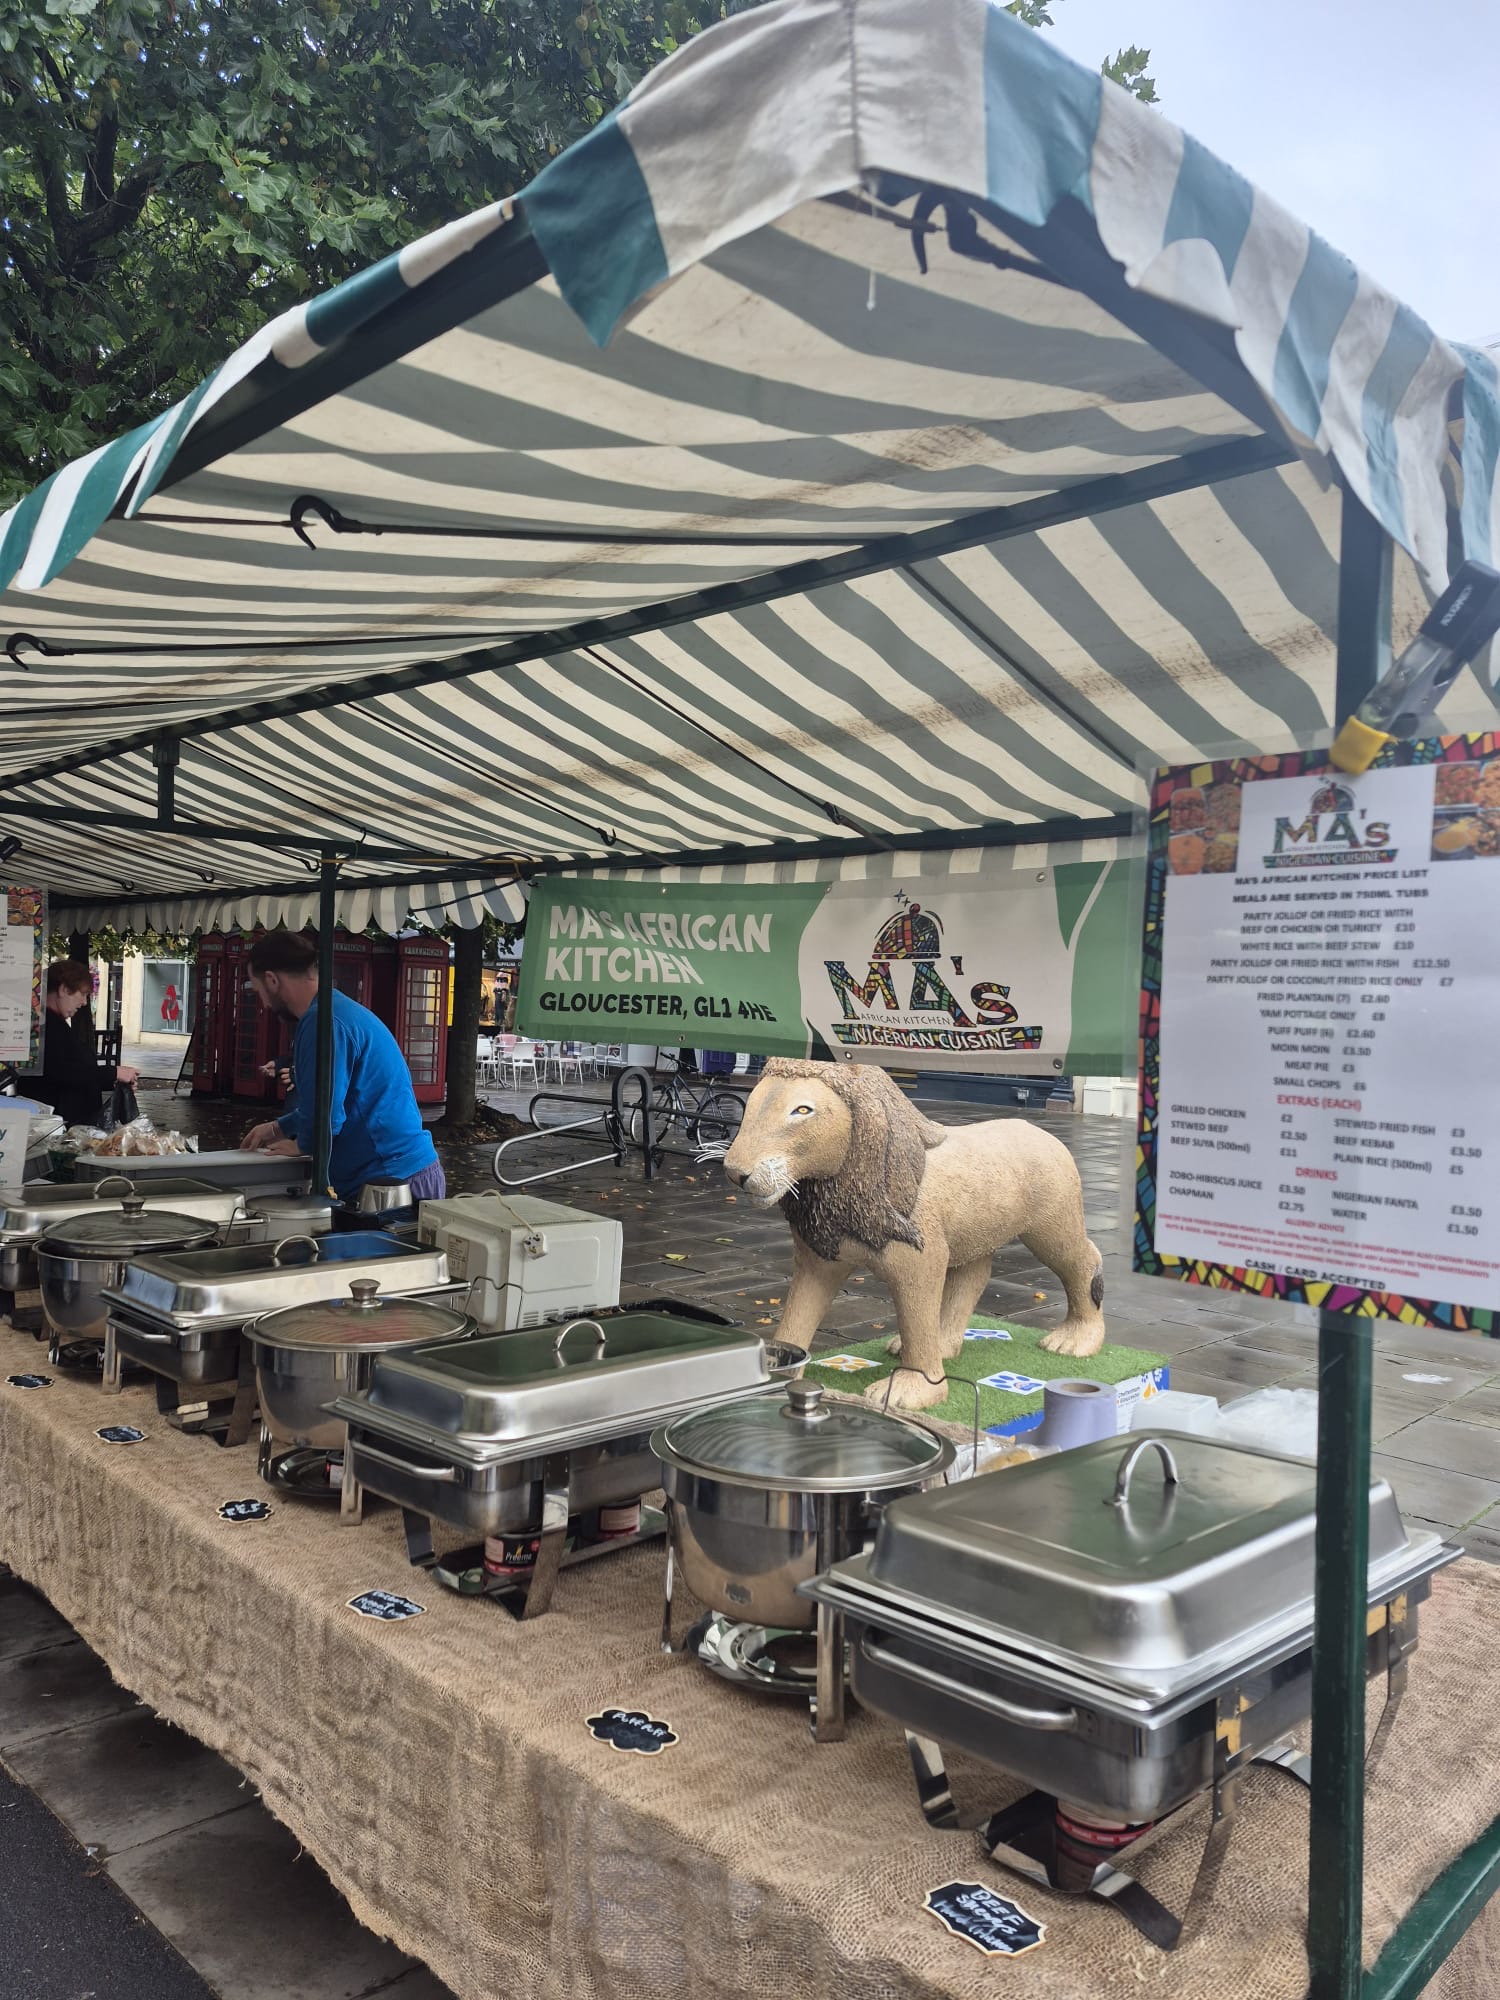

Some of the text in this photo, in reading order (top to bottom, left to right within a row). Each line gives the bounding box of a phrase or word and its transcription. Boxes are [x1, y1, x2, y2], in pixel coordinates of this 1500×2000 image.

[1272, 808, 1391, 854] MA's
[1235, 869, 1428, 885] MA'S AFRICAN KITCHEN PRICE LIST
[1232, 888, 1429, 903] MEALS ARE SERVED IN 750ML TUBS
[1243, 908, 1413, 920] PARTY JOLLOF OR FRIED RICE WITH
[549, 905, 773, 953] MA'S AFRICAN
[1241, 922, 1415, 934] BEEF OR CHICKEN OR TURKEY £10
[1240, 941, 1414, 951] WHITE RICE WITH BEEF STEW £10
[544, 946, 705, 985] KITCHEN
[1210, 959, 1239, 968] PARTY
[1240, 959, 1273, 968] JOLLOF
[1274, 959, 1289, 967] OR
[1290, 959, 1320, 967] FRIED
[1321, 959, 1342, 967] RICE
[1345, 959, 1374, 968] WITH
[1375, 959, 1400, 968] FISH
[1206, 975, 1234, 984] PARTY
[1235, 975, 1268, 984] JOLLOF
[1270, 976, 1285, 984] OR
[1286, 976, 1335, 985] COCONUT
[1336, 976, 1367, 986] FRIED
[1368, 976, 1393, 986] RICE
[1394, 977, 1423, 986] ONLY
[824, 955, 1019, 1028] MA's
[1257, 992, 1285, 1001] FRIED
[1286, 992, 1334, 1002] PLANTAIN
[539, 992, 777, 1022] GLOUCESTER, GL1 4HE
[860, 1012, 951, 1026] AFRICAN KITCHEN
[1259, 1009, 1282, 1018] YAM
[1283, 1010, 1327, 1020] POTTAGE
[1329, 1011, 1356, 1021] ONLY
[1267, 1026, 1291, 1035] PUFF
[1294, 1027, 1318, 1036] PUFF
[852, 1028, 1016, 1050] NIGERIAN CUISINE
[1271, 1043, 1299, 1052] MOIN
[1301, 1044, 1330, 1054] MOIN
[1285, 1061, 1312, 1070] MEAT
[1313, 1062, 1329, 1072] PIE
[1273, 1077, 1305, 1088] SMALL
[1307, 1079, 1341, 1090] CHOPS
[1277, 1094, 1362, 1112] EXTRAS (EACH)
[1171, 1104, 1206, 1115] GRILLED
[1207, 1107, 1247, 1119] CHICKEN
[1170, 1120, 1206, 1131] STEWED
[1207, 1123, 1229, 1133] BEEF
[1334, 1118, 1377, 1130] STEWED
[1379, 1122, 1409, 1133] FRIED
[1411, 1124, 1436, 1136] FISH
[1170, 1136, 1191, 1146] BEEF
[1192, 1138, 1215, 1149] SUYA
[1334, 1135, 1358, 1146] BEEF
[1360, 1138, 1395, 1149] KEBAB
[1333, 1153, 1364, 1164] PLAIN
[1365, 1156, 1388, 1167] RICE
[1295, 1167, 1338, 1181] DRINKS
[1238, 1179, 1262, 1190] JUICE
[1169, 1186, 1214, 1200] CHAPMAN
[1332, 1191, 1382, 1205] NIGERIAN
[1384, 1196, 1419, 1210] FANTA
[1331, 1208, 1367, 1221] WATER
[1244, 1258, 1276, 1271] CASH
[1285, 1265, 1317, 1278] CARD
[1321, 1271, 1386, 1290] ACCEPTED
[970, 1889, 1025, 1927] BEEF
